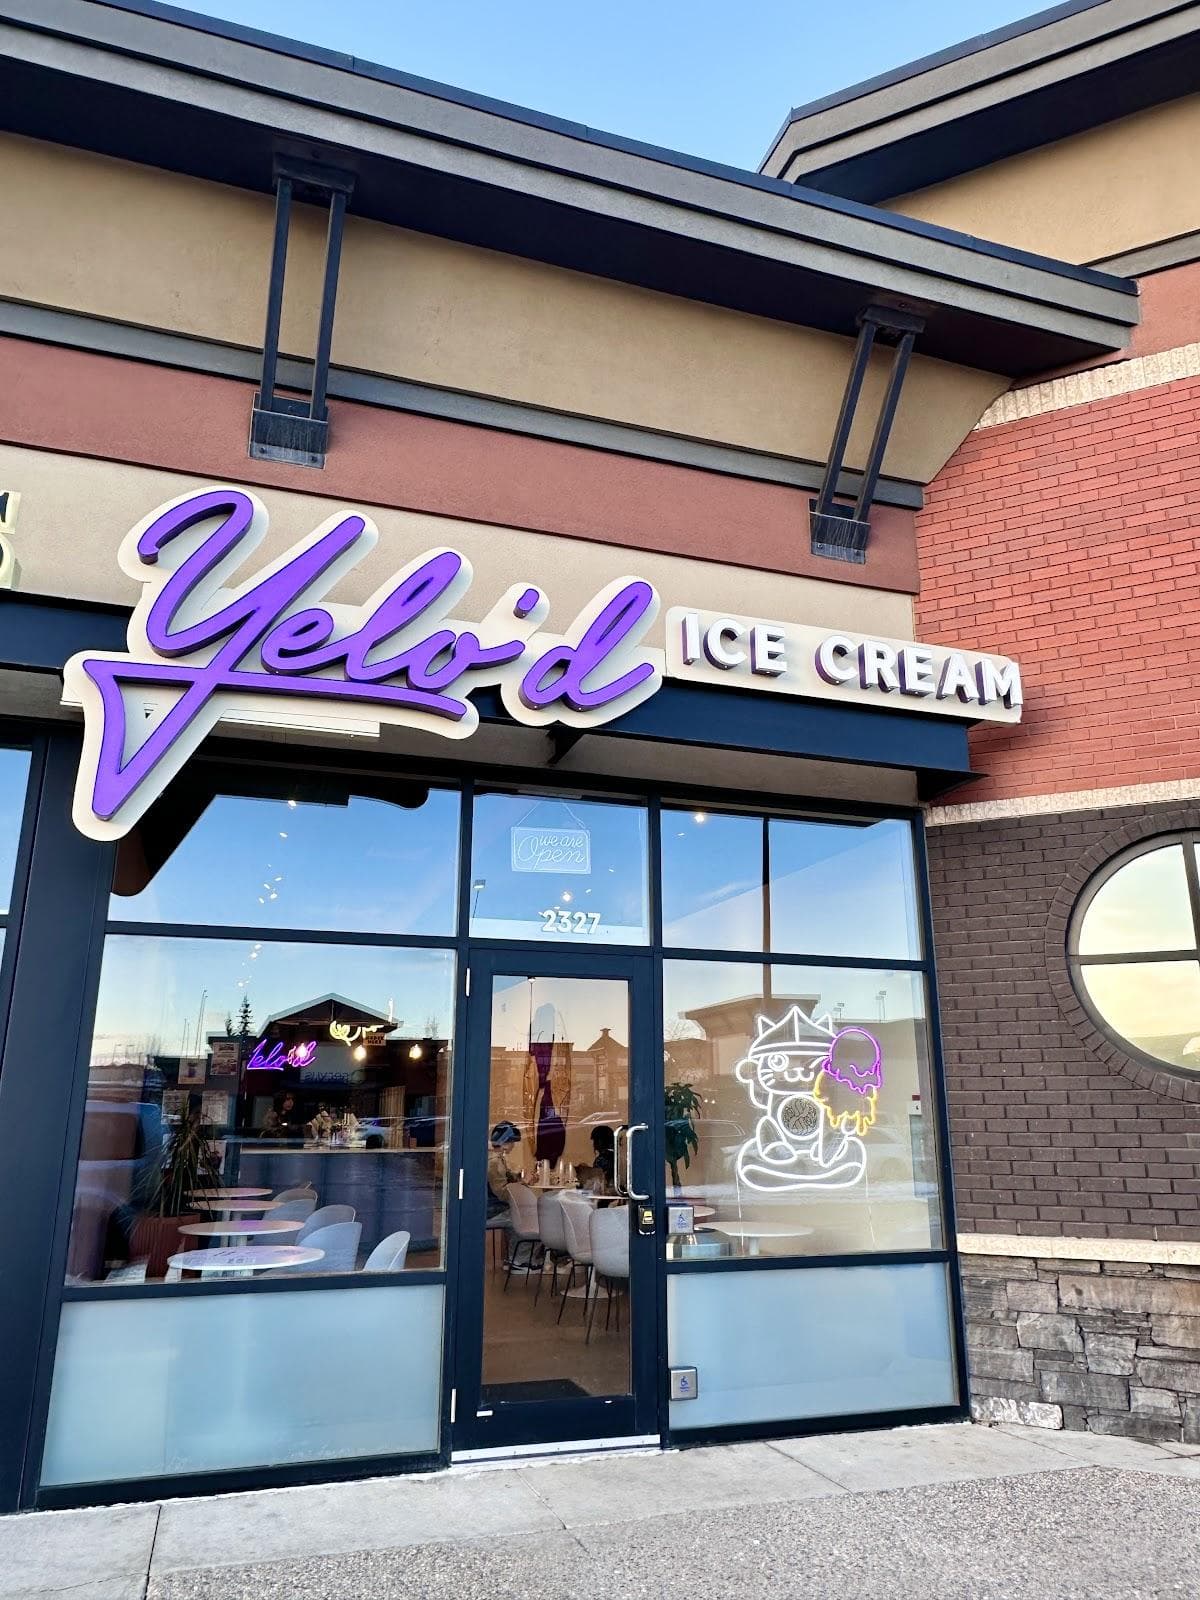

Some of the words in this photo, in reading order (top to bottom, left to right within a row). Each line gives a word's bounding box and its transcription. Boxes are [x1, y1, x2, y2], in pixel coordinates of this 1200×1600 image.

[83, 489, 654, 821] Yelo'd
[682, 612, 787, 676] ICE
[815, 634, 1023, 709] CREAM
[517, 835, 585, 871] Open
[540, 834, 559, 847] we
[560, 835, 584, 848] are
[541, 909, 601, 934] 2327
